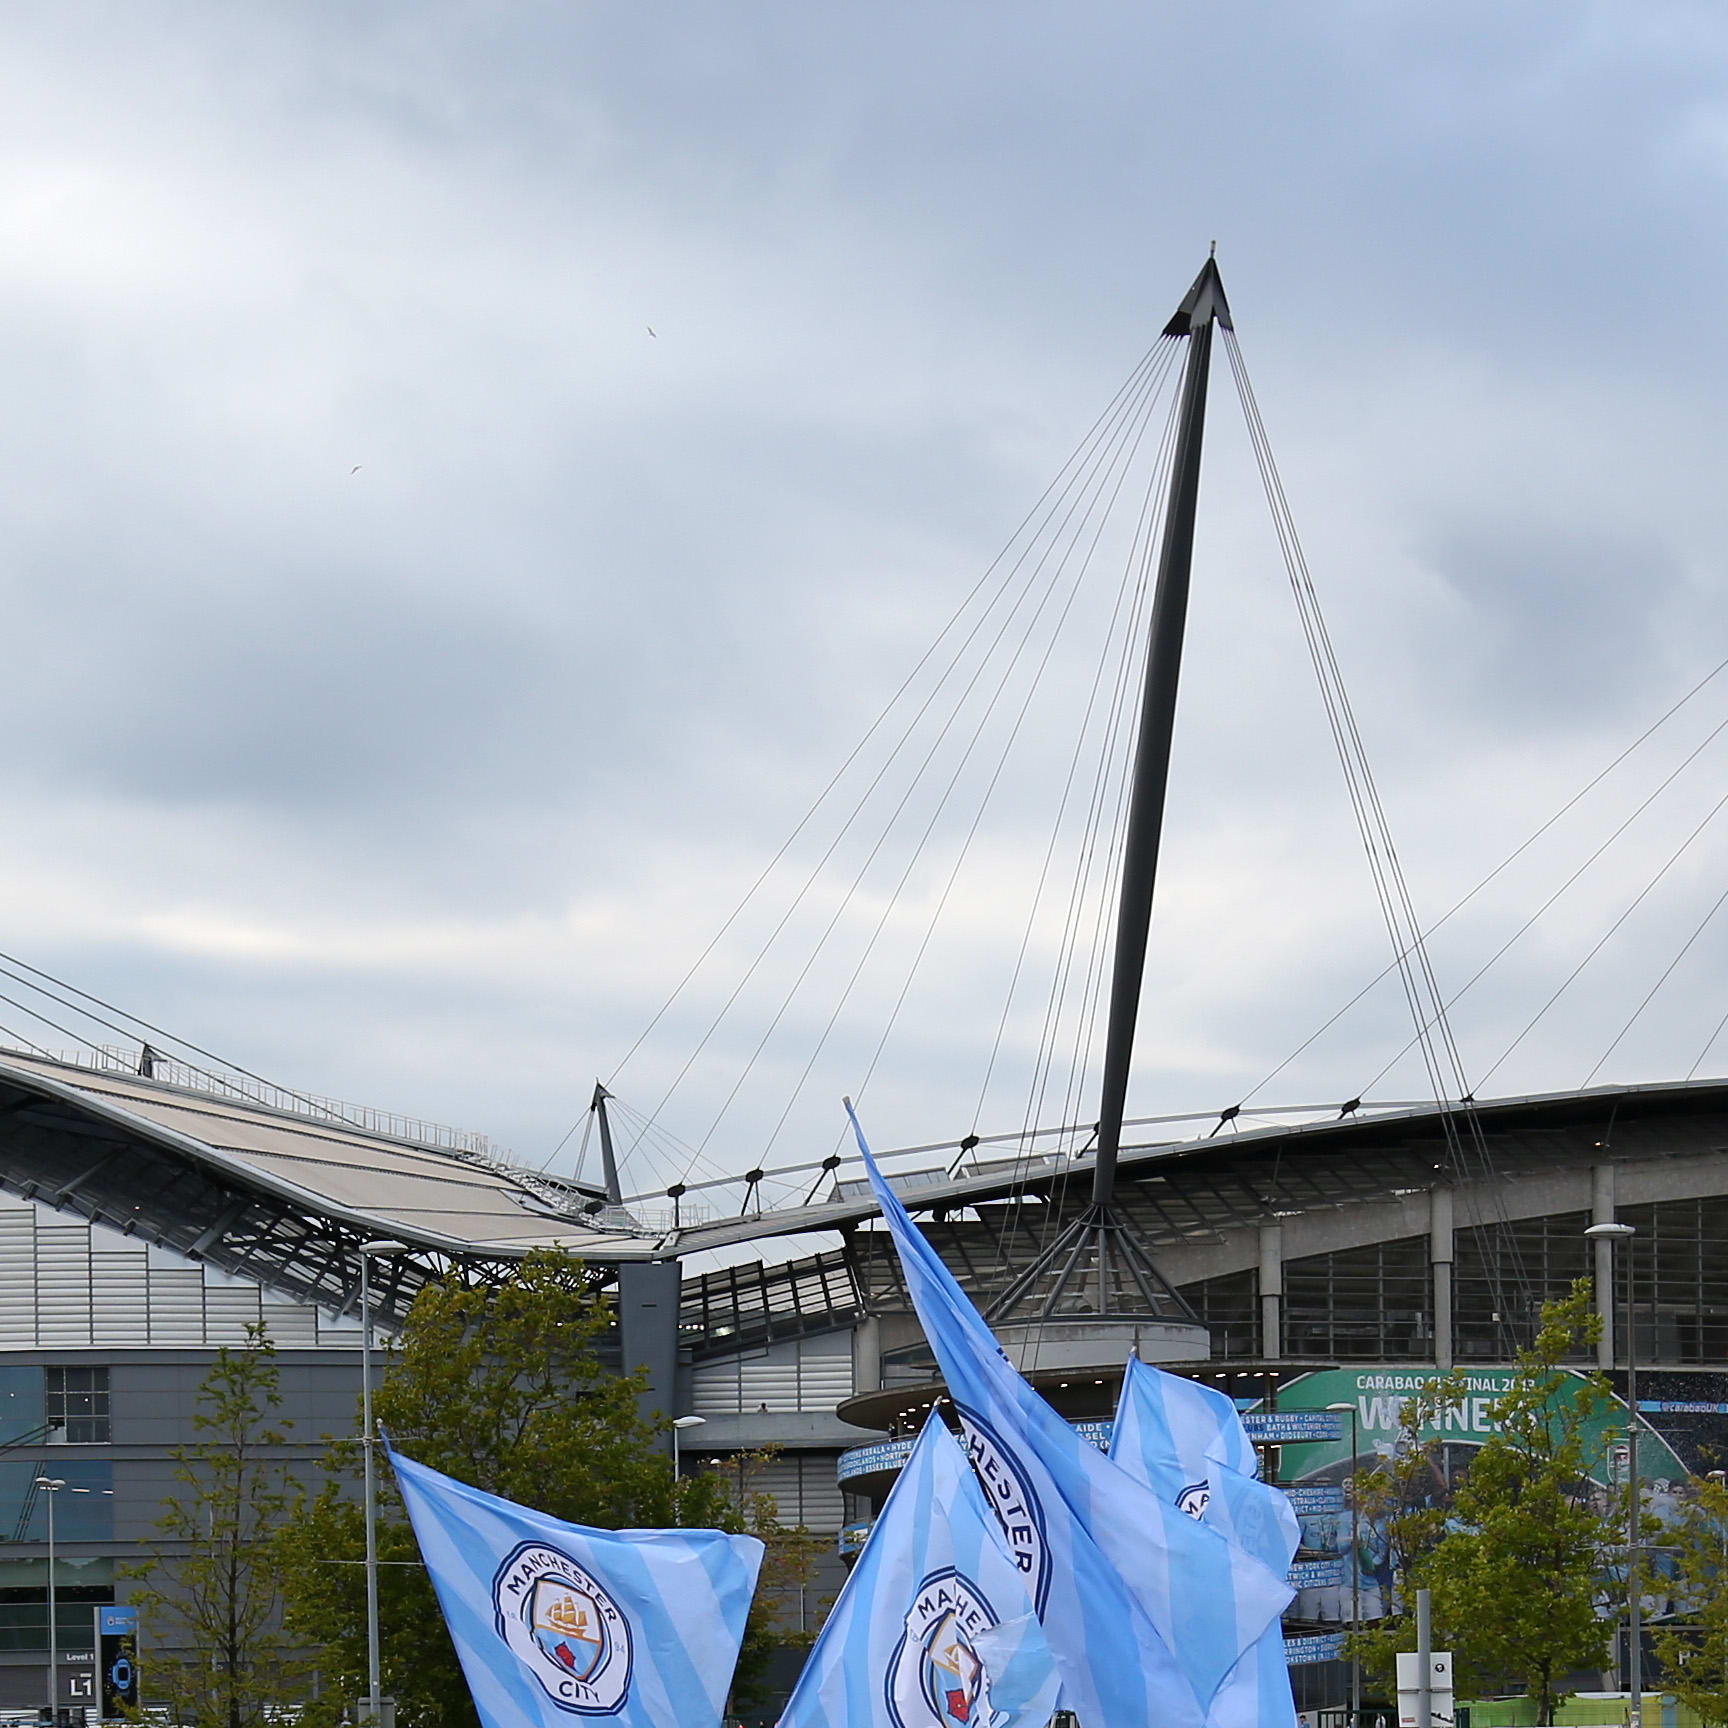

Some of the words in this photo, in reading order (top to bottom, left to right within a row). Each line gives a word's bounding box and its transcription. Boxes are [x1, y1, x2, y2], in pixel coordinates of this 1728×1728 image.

[1357, 1375, 1423, 1390] CARABAO
[507, 1553, 617, 1623] MANCHESTER
[66, 1653, 85, 1661] Level
[71, 1678, 92, 1696] L1
[559, 1681, 600, 1703] CITY
